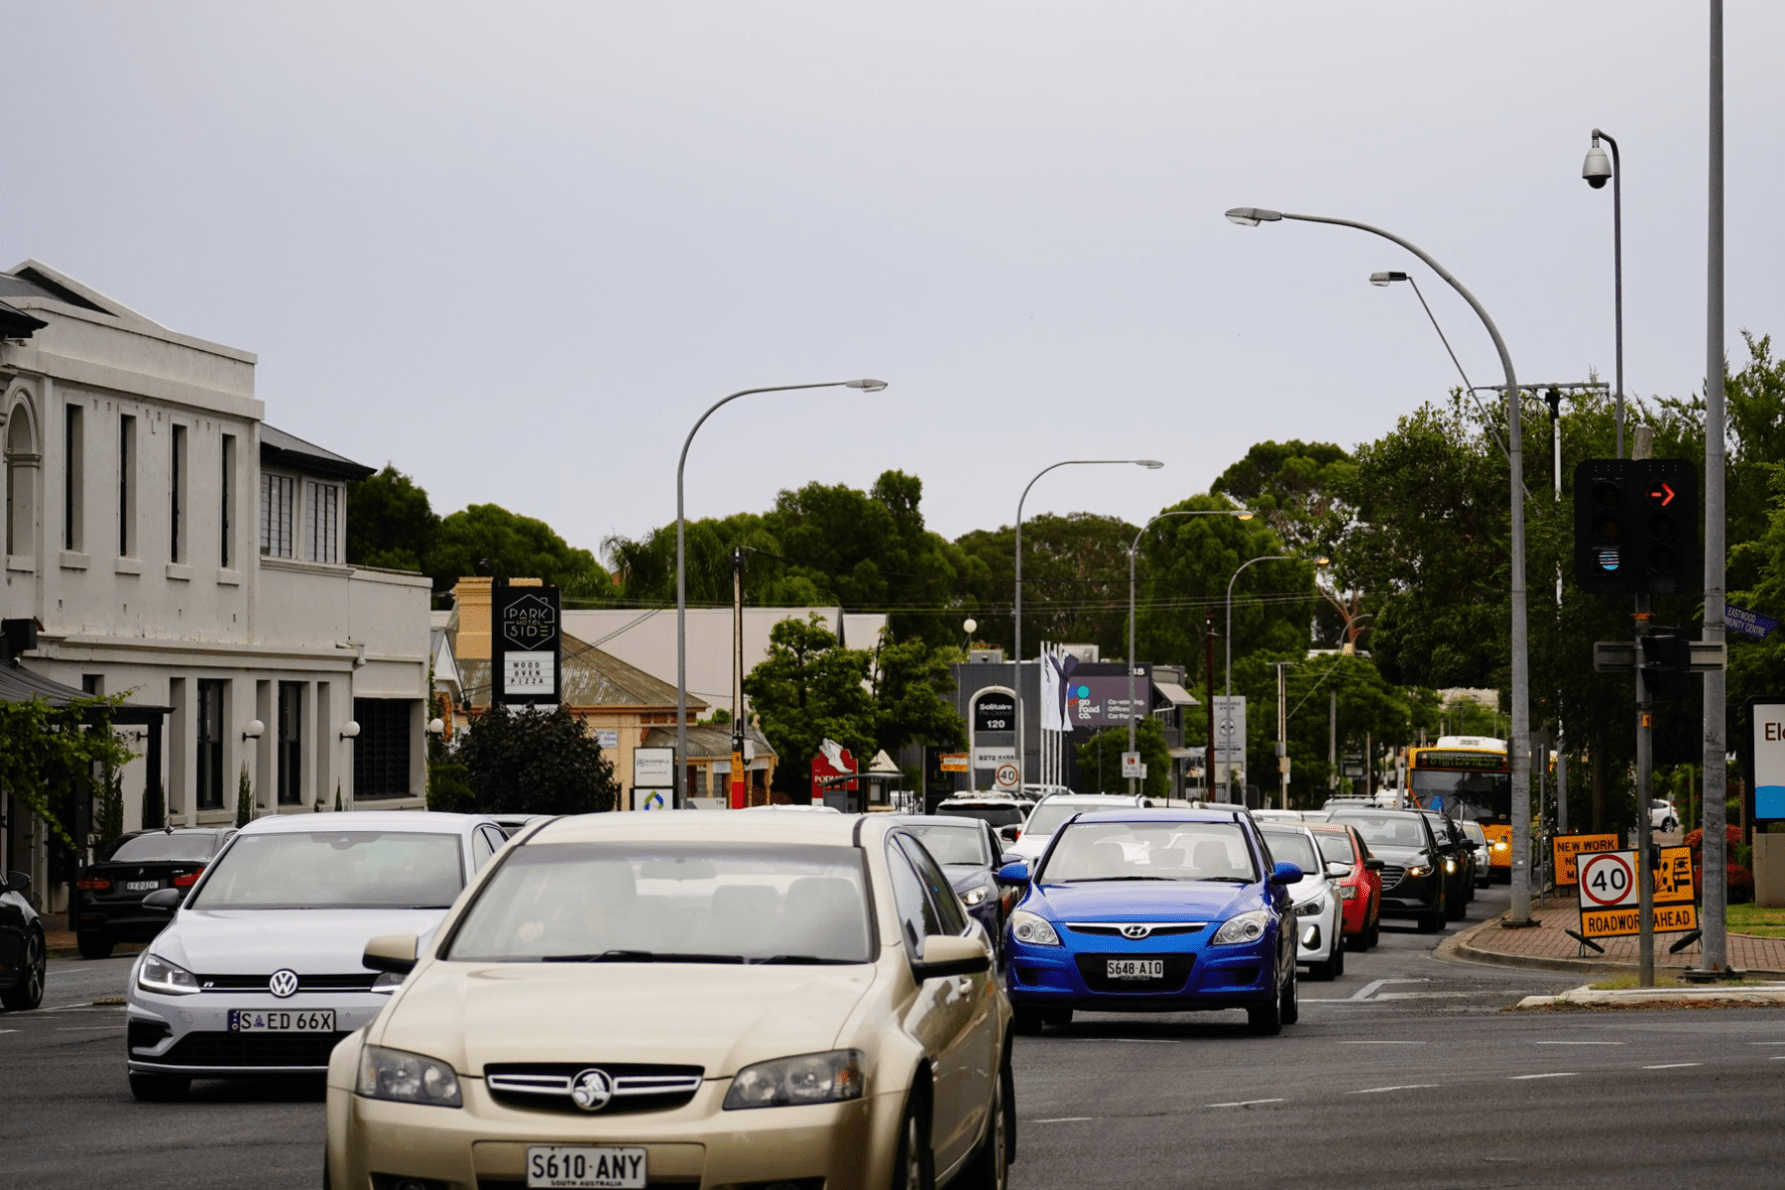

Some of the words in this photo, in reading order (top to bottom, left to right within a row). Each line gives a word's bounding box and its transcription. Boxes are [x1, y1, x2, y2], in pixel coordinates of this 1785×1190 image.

[510, 608, 548, 619] PARK
[1728, 606, 1756, 624] EASTWOOD
[510, 626, 548, 637] SIDE
[1745, 622, 1766, 637] CENTRE
[979, 703, 1013, 711] Solitaire
[1078, 699, 1091, 707] go
[1078, 705, 1100, 713] road
[986, 719, 1006, 729] 120
[1000, 770, 1016, 781] 40
[1557, 841, 1580, 852] NEW
[1584, 839, 1615, 851] WORK
[1592, 868, 1626, 891] 40
[1588, 914, 1640, 932] ROADWOR
[1653, 910, 1690, 928] AHEAD
[241, 1013, 252, 1029] S
[267, 1013, 290, 1029] ED
[297, 1013, 331, 1029] 66X
